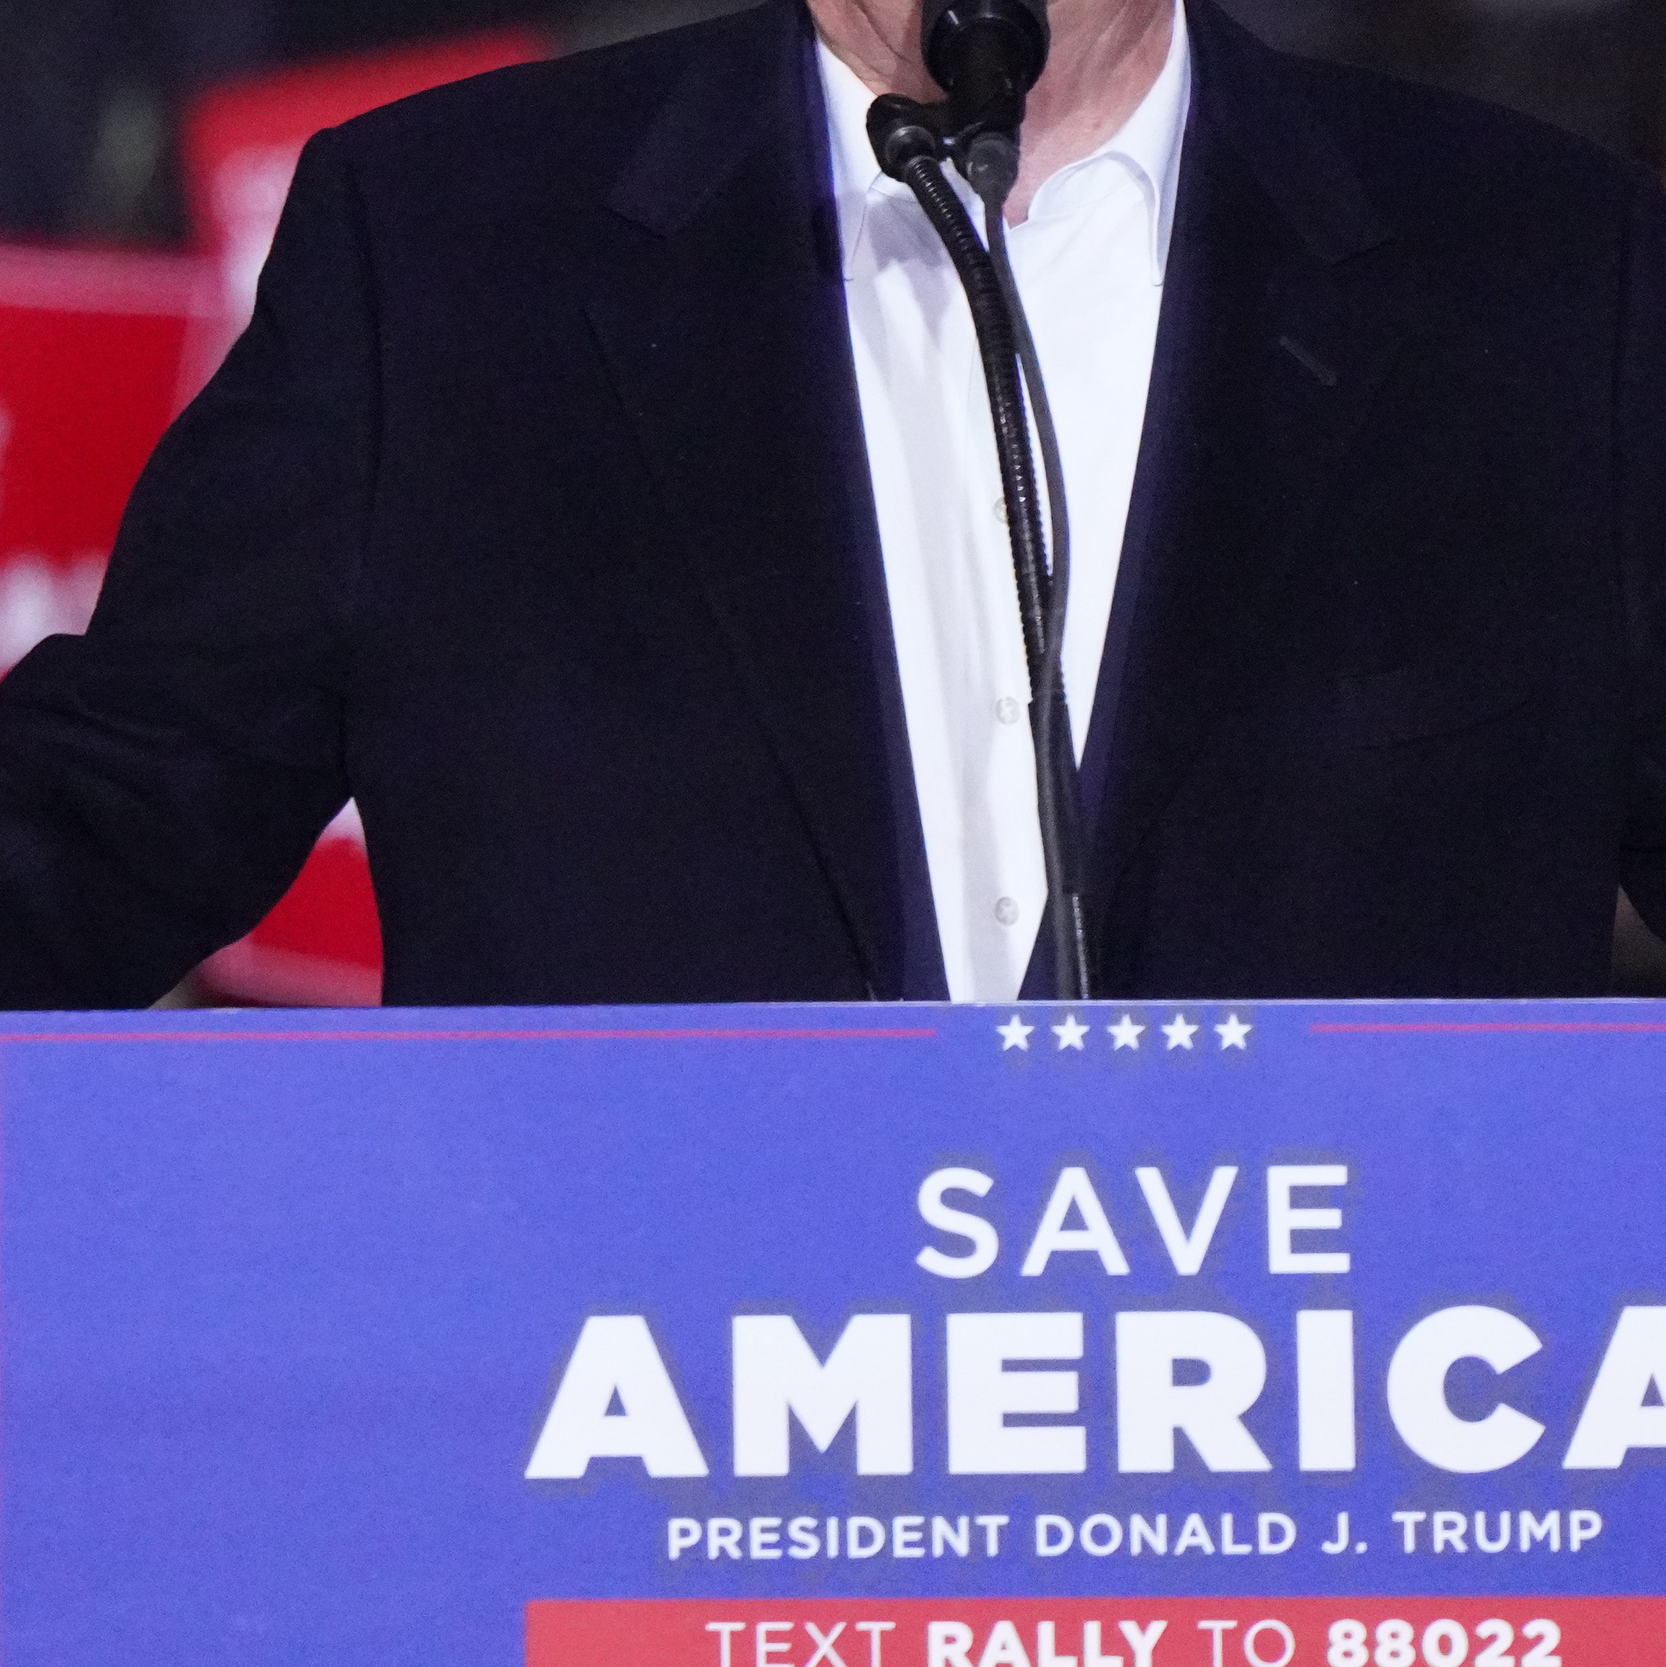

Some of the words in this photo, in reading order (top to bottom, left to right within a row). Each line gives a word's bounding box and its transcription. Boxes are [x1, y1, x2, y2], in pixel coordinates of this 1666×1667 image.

[916, 1164, 1353, 1279] SAVE
[667, 1515, 1010, 1561] PRESIDENT
[1035, 1512, 1297, 1558] DONALD
[1320, 1512, 1369, 1555] J.
[1392, 1509, 1603, 1553] TRUMP
[705, 1620, 897, 1667] TEXT
[927, 1619, 1168, 1667] RALLY
[1196, 1618, 1296, 1667] TO
[1325, 1617, 1563, 1667] 88022
